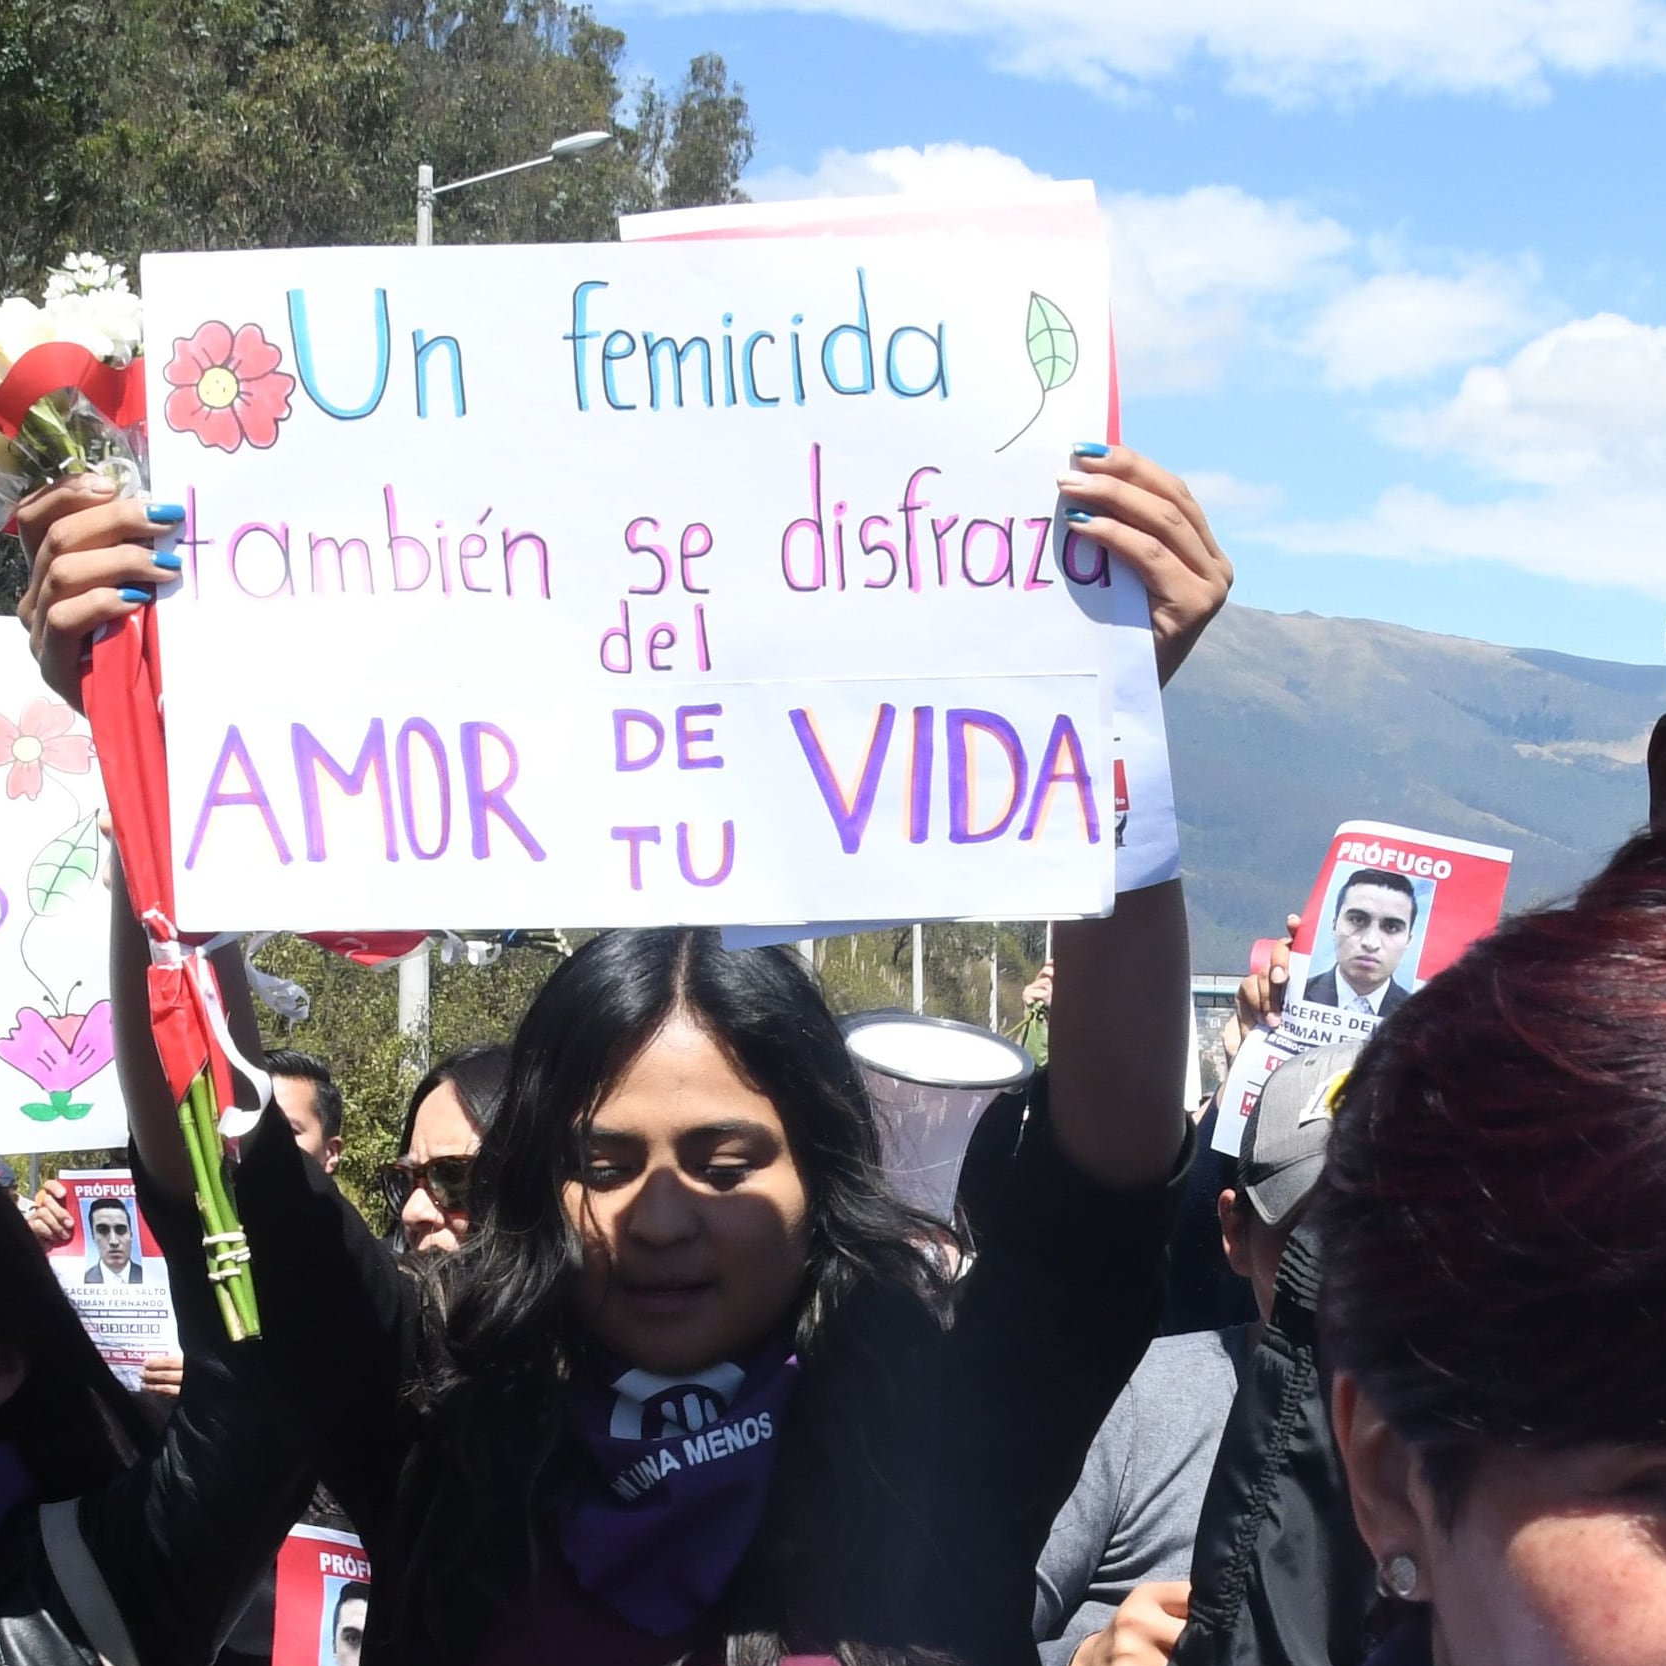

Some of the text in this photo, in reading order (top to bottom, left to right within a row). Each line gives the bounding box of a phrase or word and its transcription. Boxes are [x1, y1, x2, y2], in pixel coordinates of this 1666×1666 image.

[286, 266, 953, 422] Un femicida
[175, 482, 551, 601] también
[626, 514, 713, 597] se
[600, 600, 713, 673] del
[614, 702, 724, 772] DE
[184, 715, 547, 870] AMOR
[788, 702, 1100, 856] VIDA
[610, 818, 735, 892] TU
[1336, 840, 1453, 880] PRÓFUGO
[629, 1448, 681, 1491] UNA
[682, 1411, 774, 1467] MENOS
